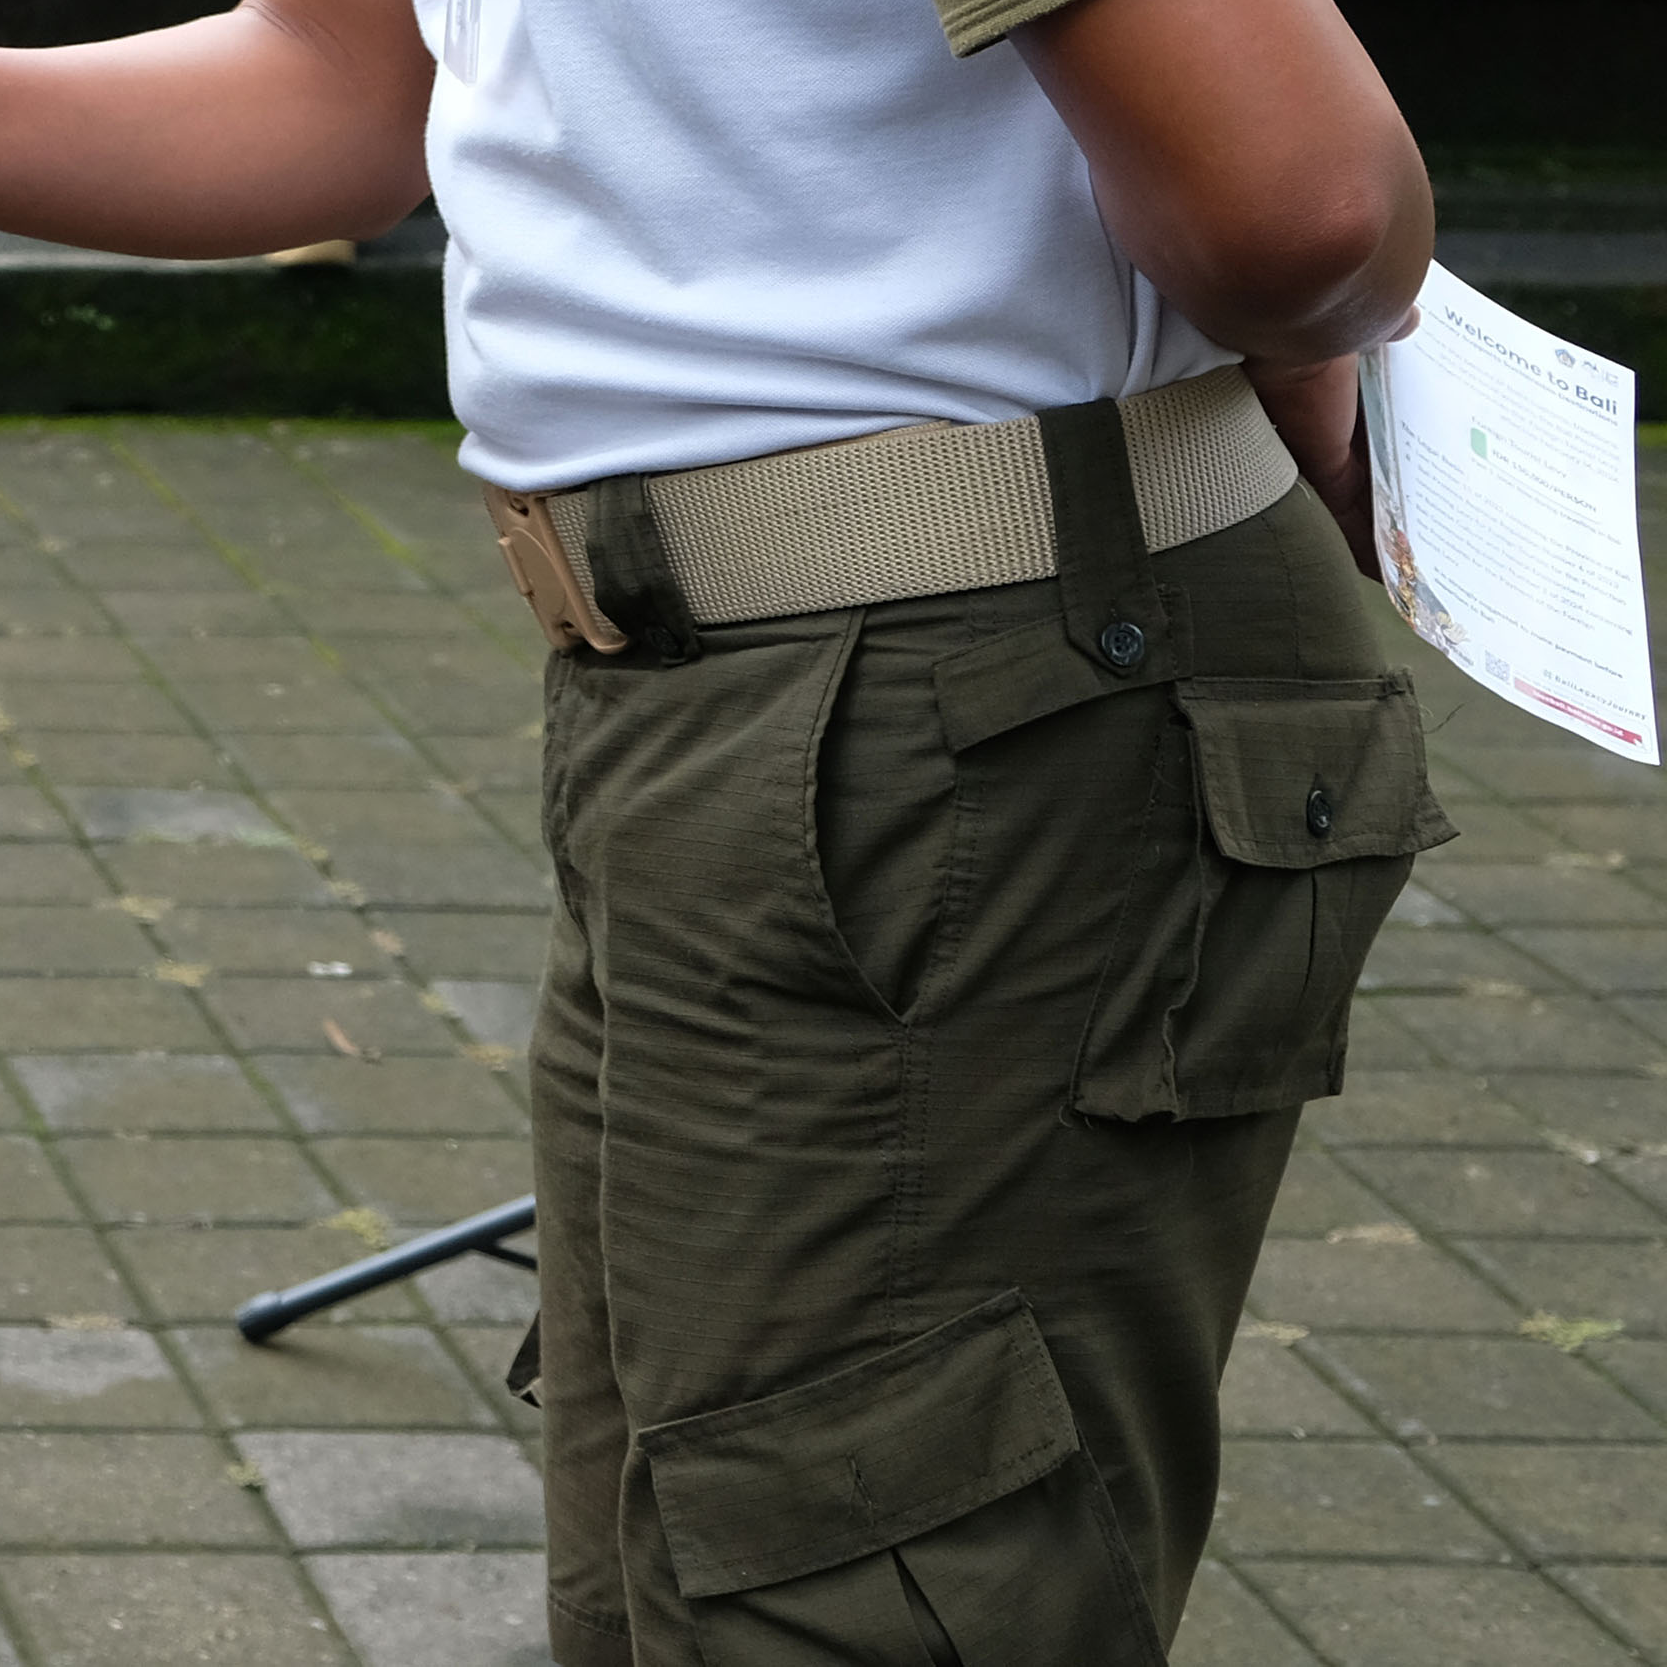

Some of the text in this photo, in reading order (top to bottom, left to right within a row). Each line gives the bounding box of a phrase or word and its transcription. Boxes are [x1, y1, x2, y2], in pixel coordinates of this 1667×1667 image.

[1445, 305, 1541, 377] Welcome
[1548, 371, 1569, 391] to
[1575, 385, 1617, 416] Bali
